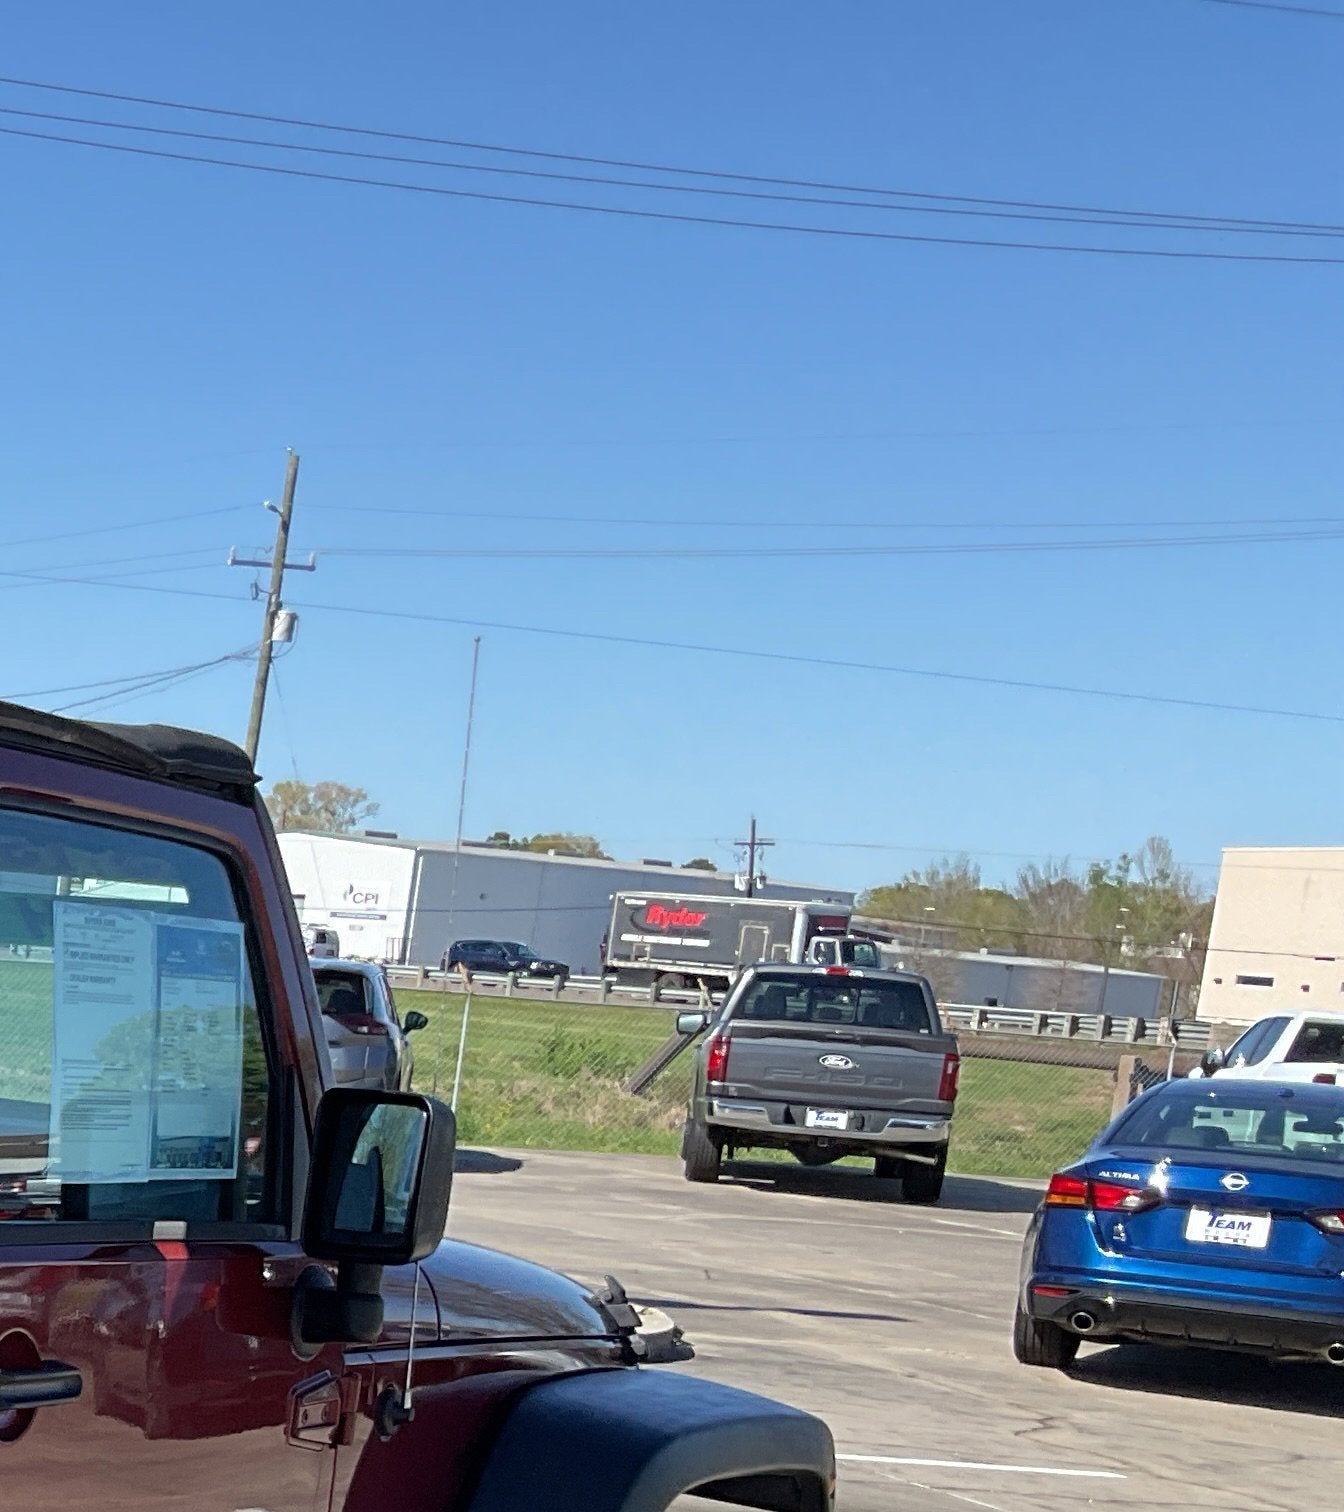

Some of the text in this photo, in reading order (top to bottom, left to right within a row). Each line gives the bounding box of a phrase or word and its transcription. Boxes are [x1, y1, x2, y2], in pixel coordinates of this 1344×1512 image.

[352, 892, 379, 905] CPI
[645, 903, 707, 929] Ryder
[822, 1056, 850, 1067] Ford
[1098, 1171, 1140, 1180] ALTIMA
